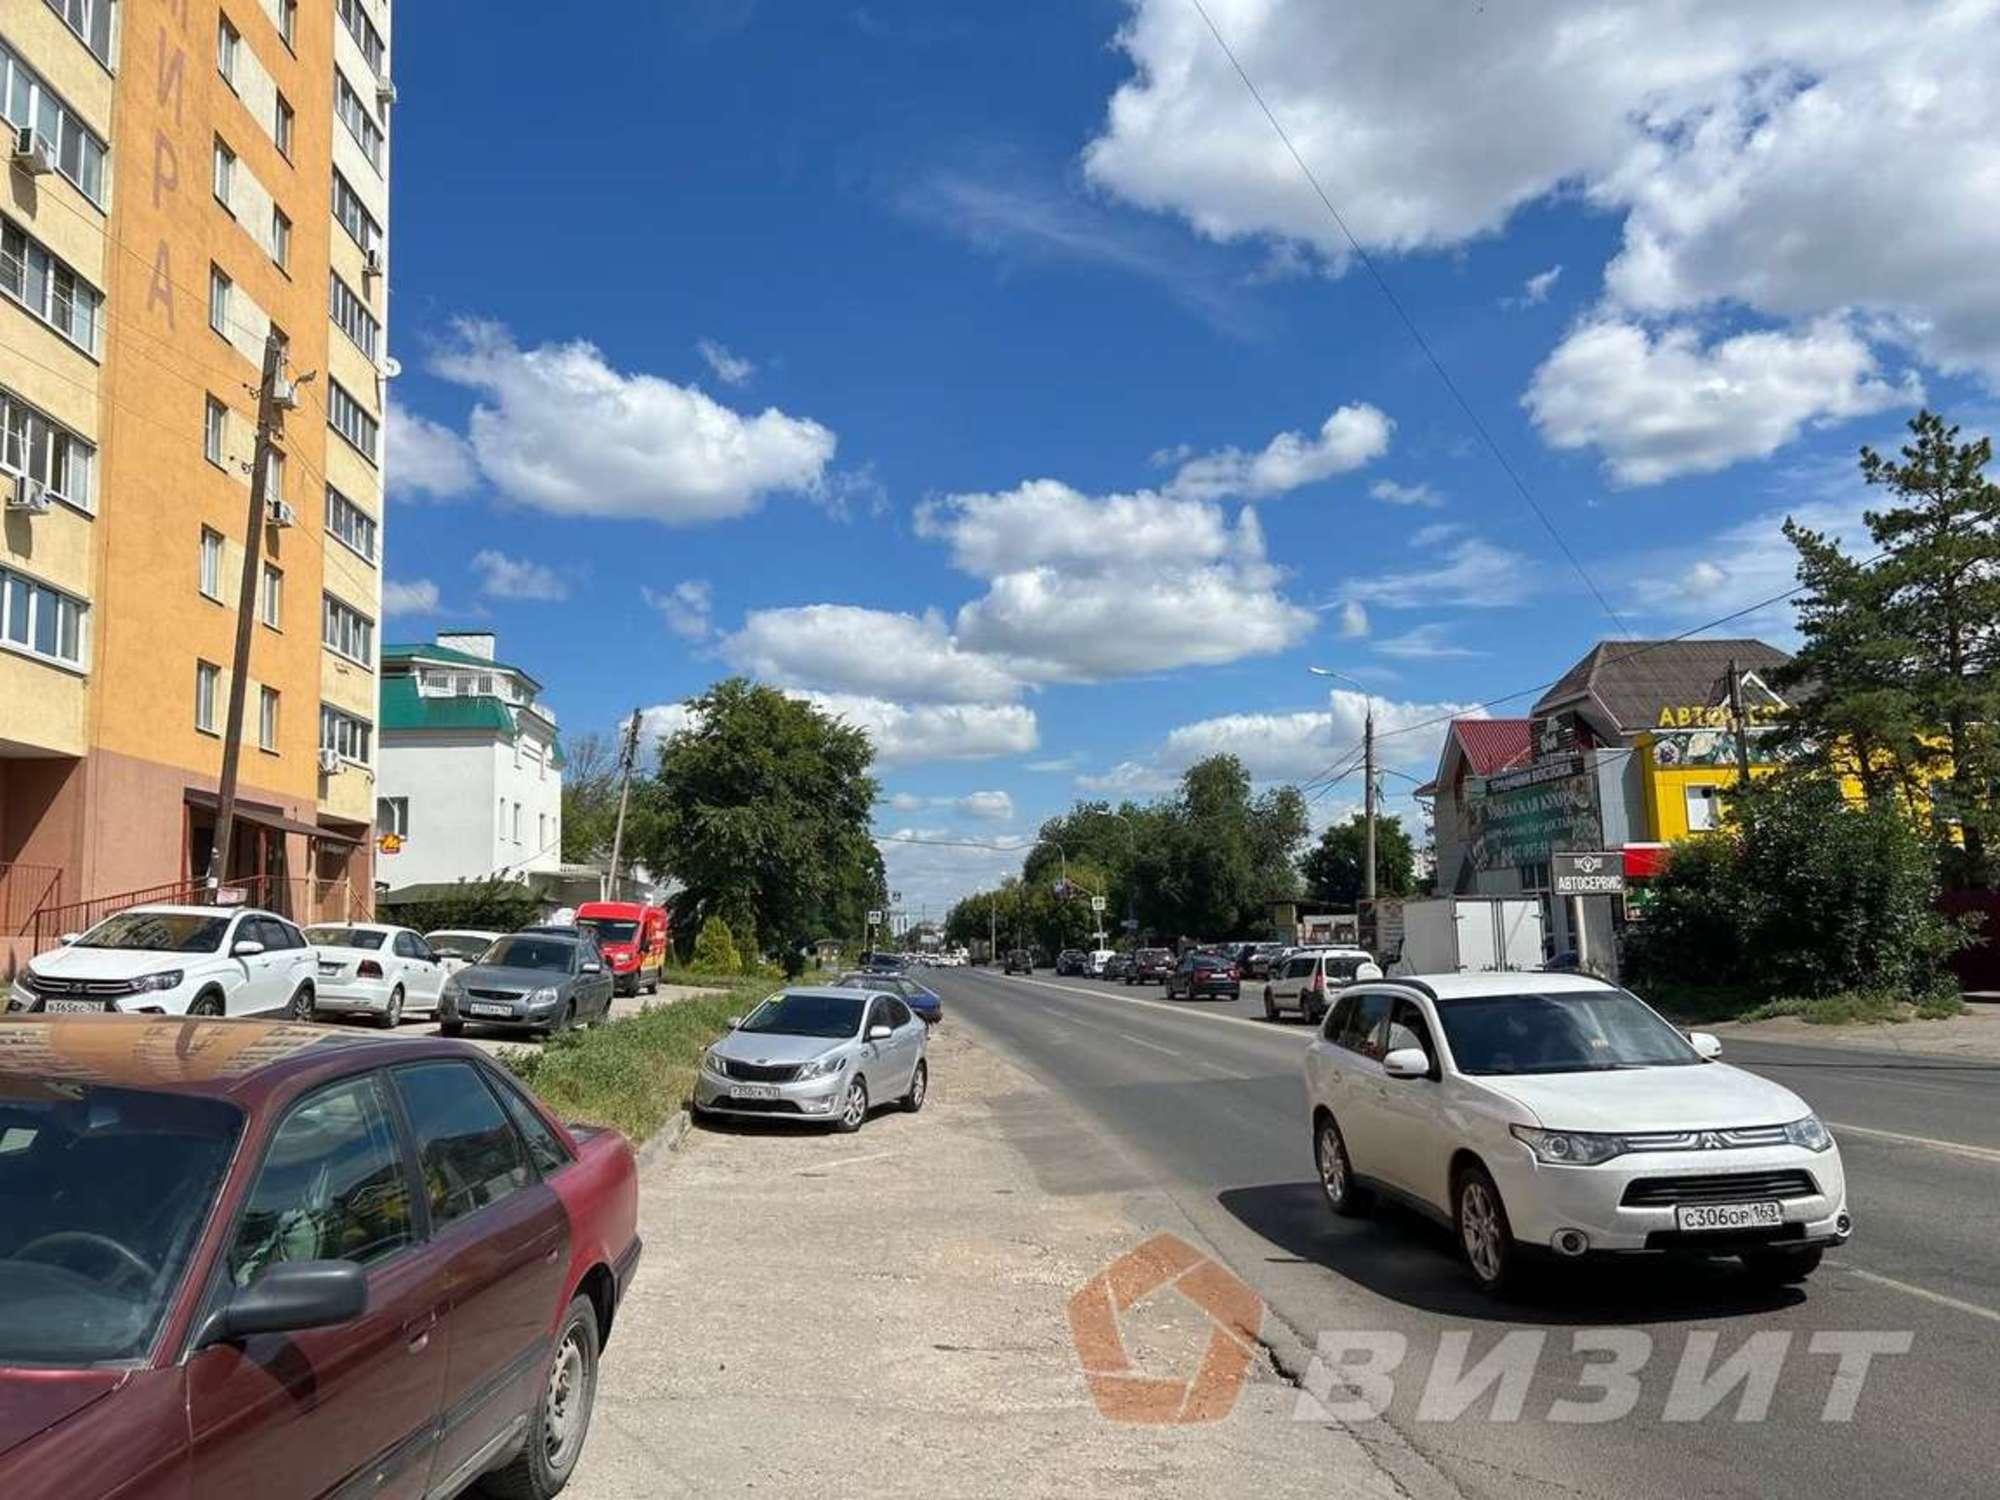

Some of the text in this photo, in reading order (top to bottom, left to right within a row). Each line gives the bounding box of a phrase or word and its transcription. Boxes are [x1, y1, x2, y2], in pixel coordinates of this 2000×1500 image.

[1558, 875, 1622, 890] АВТОСЕРВИС
[1684, 1204, 1776, 1227] С306ОР 163
